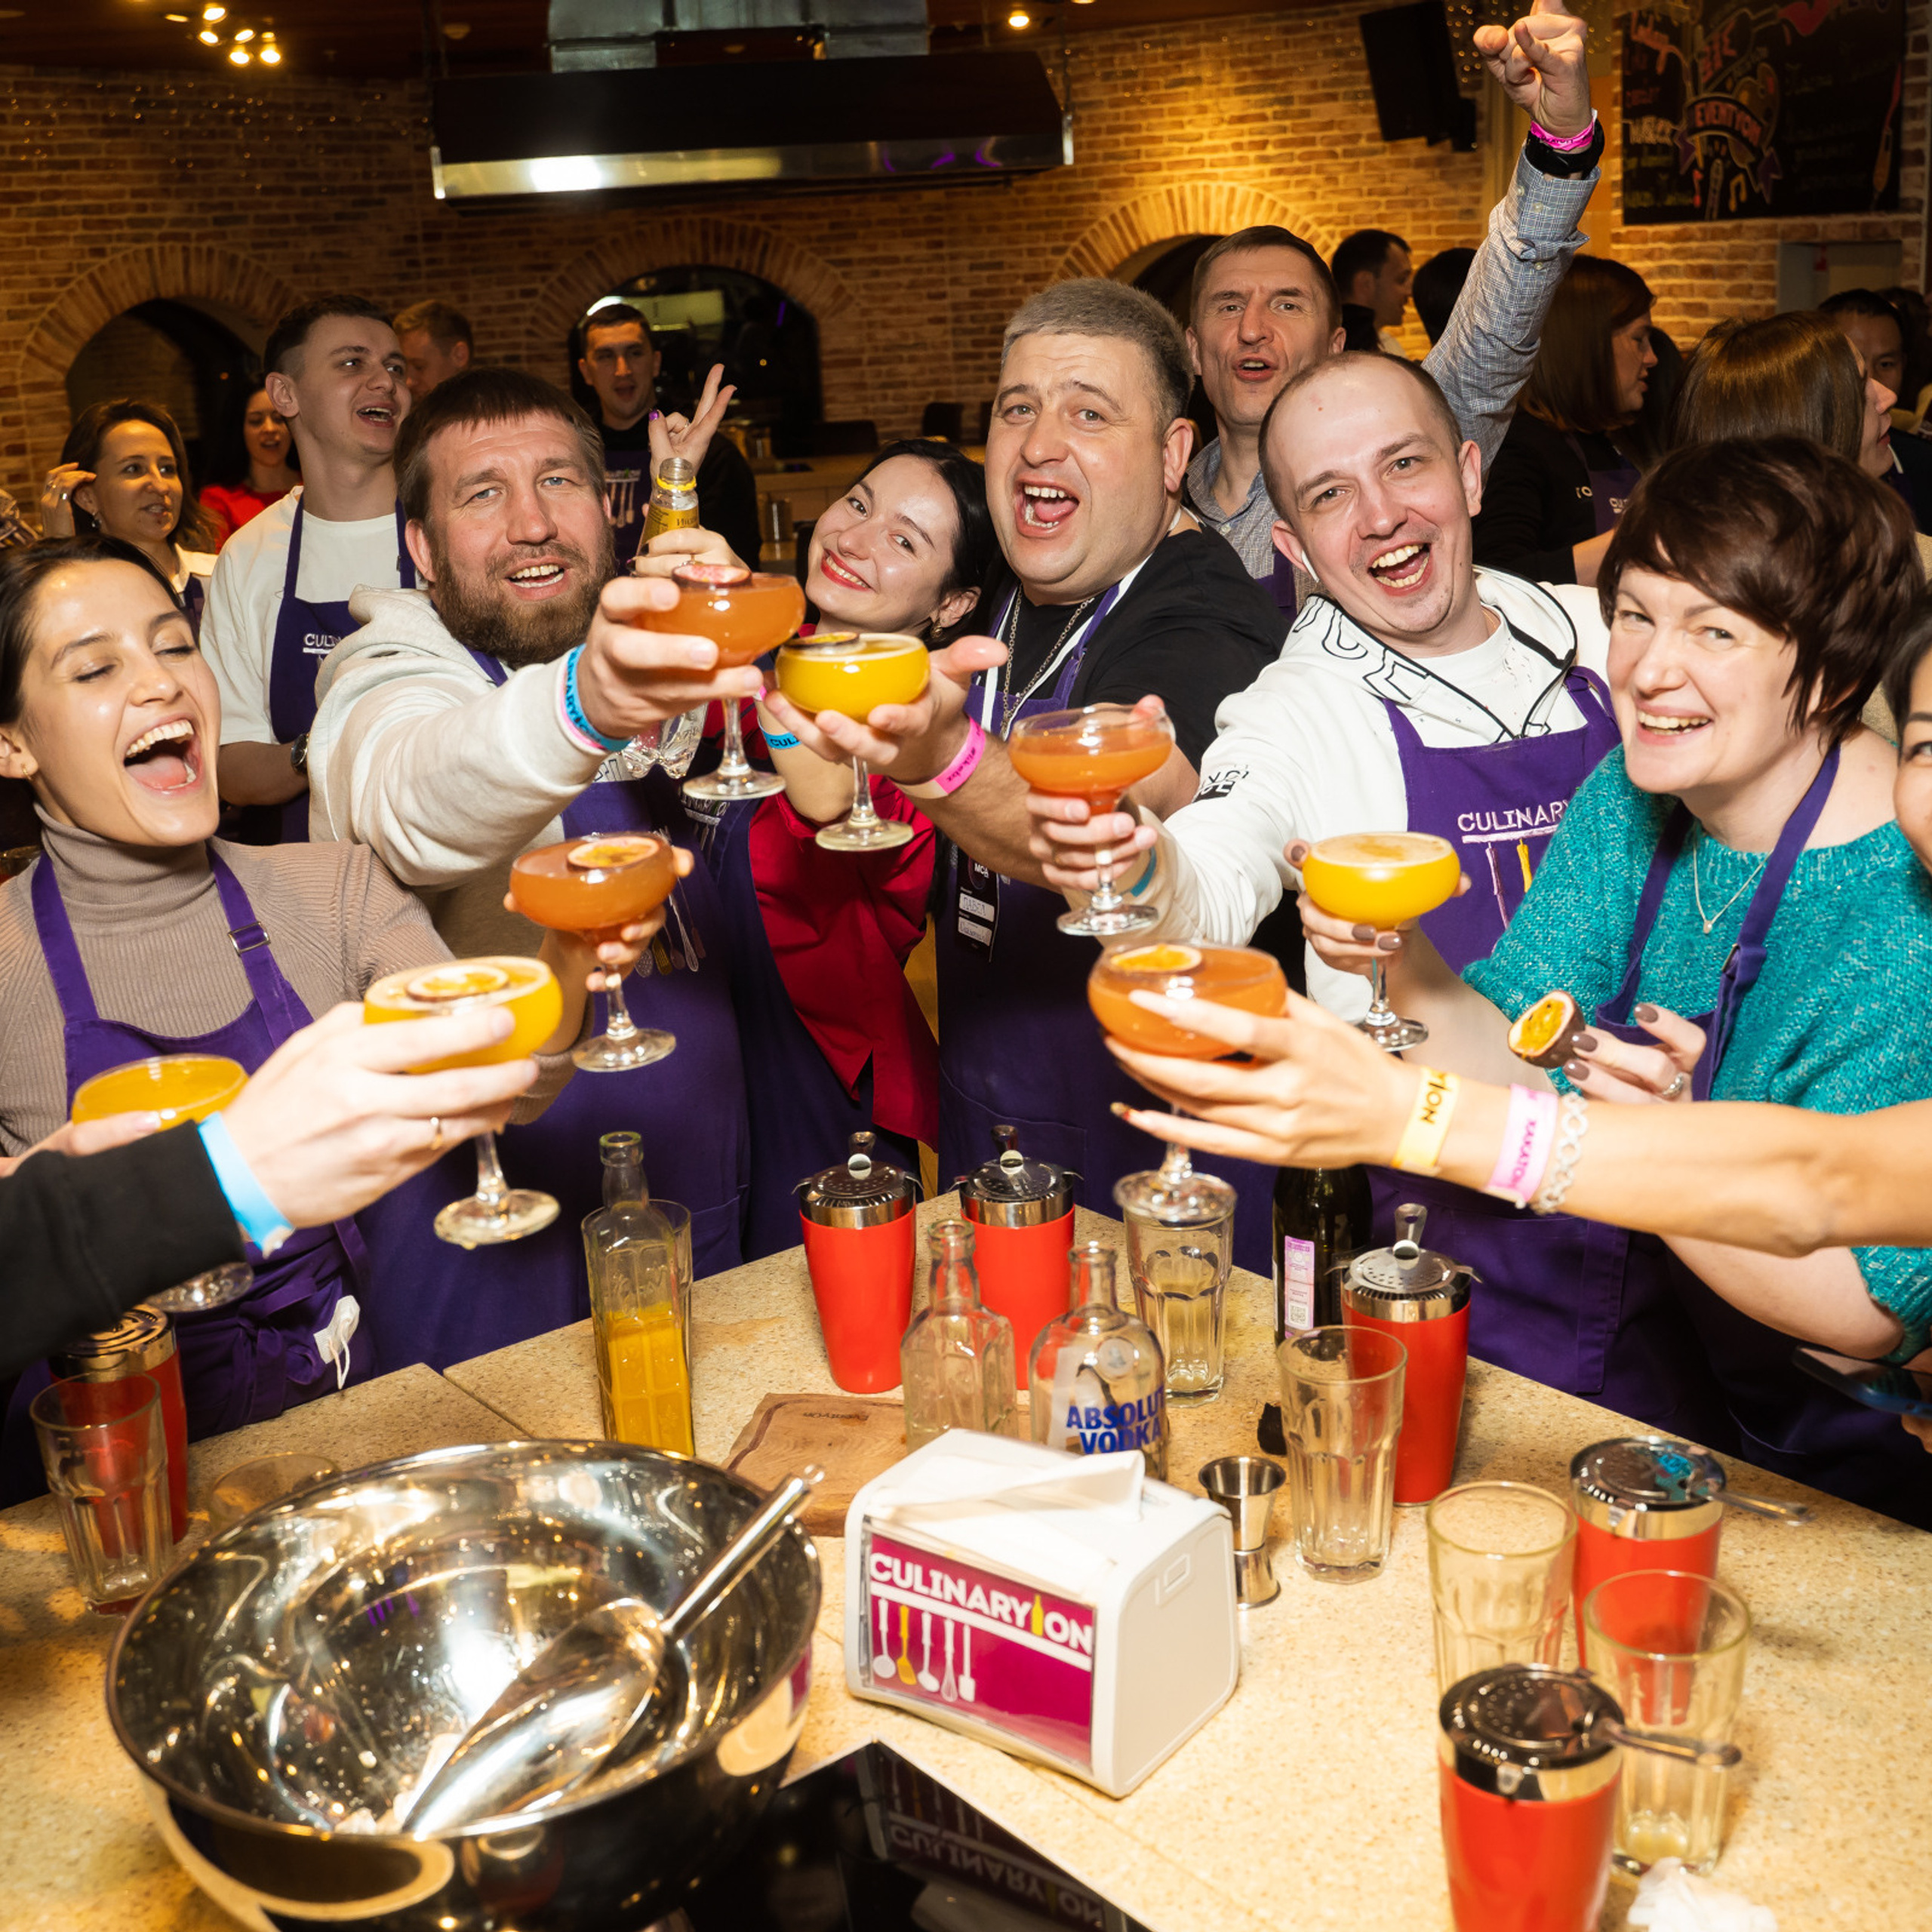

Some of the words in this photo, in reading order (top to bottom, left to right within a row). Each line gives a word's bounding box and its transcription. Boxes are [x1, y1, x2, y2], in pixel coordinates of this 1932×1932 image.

[1066, 1386, 1164, 1429] ABSOLUT
[1080, 1417, 1161, 1455] VODKA
[869, 1552, 1033, 1629] CULINARY
[1044, 1611, 1093, 1656] ON
